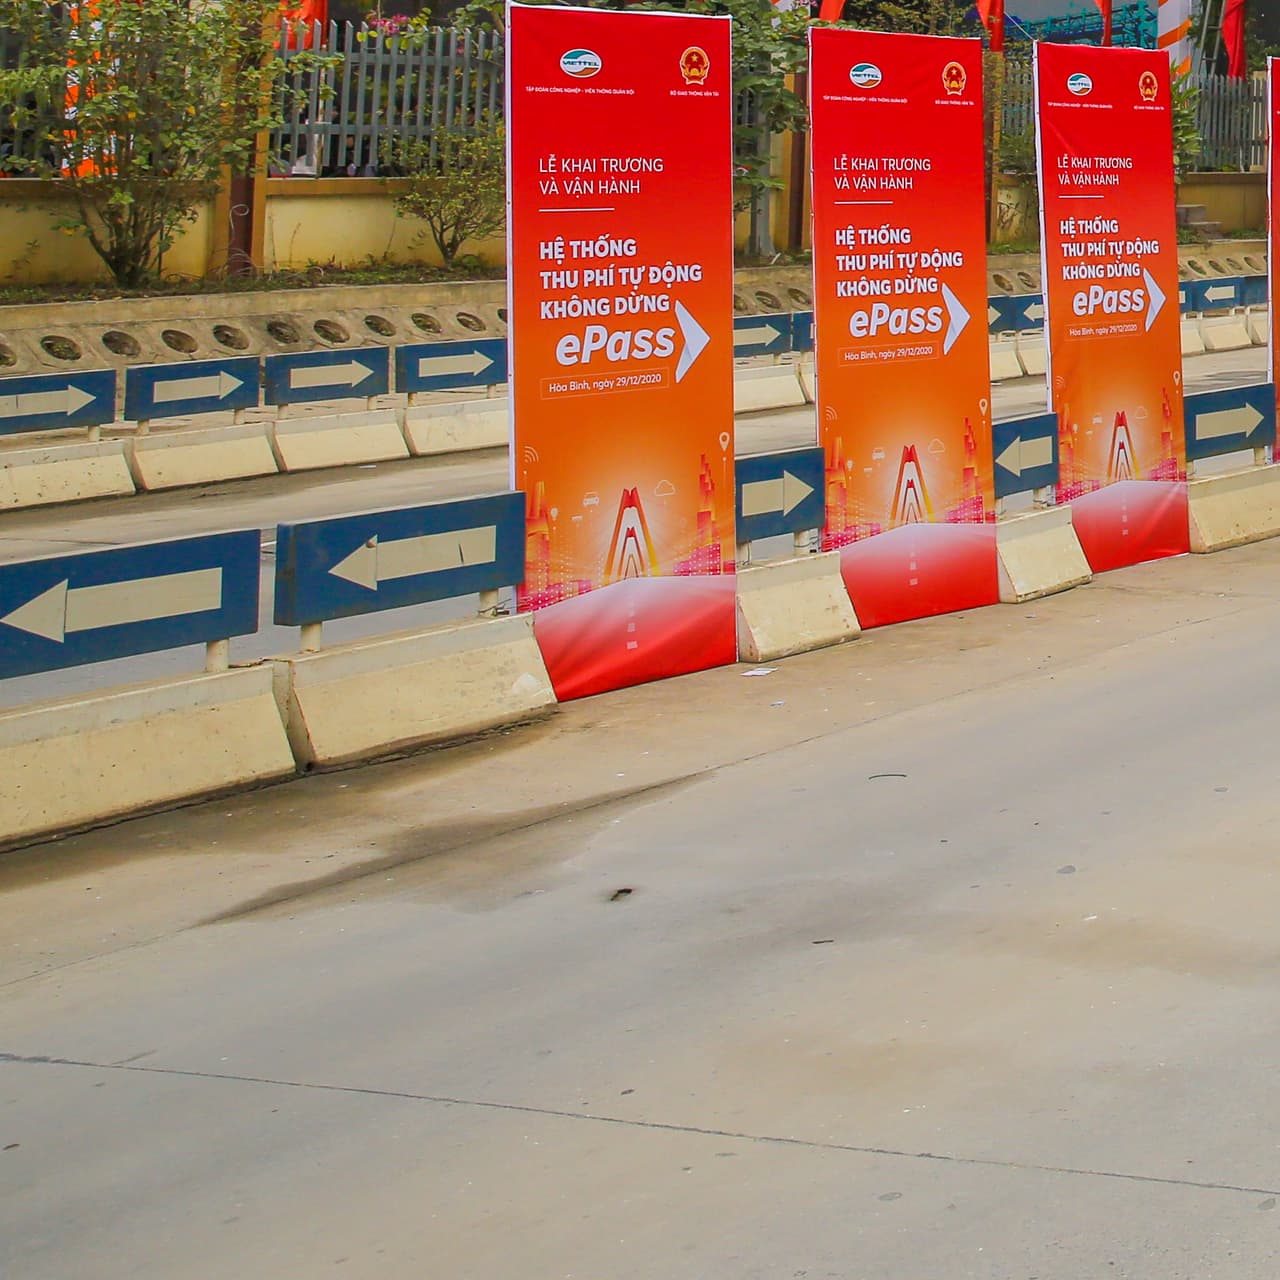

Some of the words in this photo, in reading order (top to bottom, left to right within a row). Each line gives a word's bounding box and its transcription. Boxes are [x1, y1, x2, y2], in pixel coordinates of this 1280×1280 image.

[539, 153, 557, 173] LỄ
[562, 158, 596, 173] KHAI
[600, 157, 665, 173] TRƯƠNG
[834, 154, 848, 170] LỄ
[851, 158, 878, 170] KHAI
[882, 157, 931, 170] TRƯƠNG
[1057, 153, 1069, 169] LỄ
[1071, 158, 1091, 169] KHAI
[1094, 157, 1133, 169] TRƯƠNG
[539, 176, 559, 195] VÀ
[563, 176, 594, 199] VẬN
[599, 176, 640, 195] HÀNH
[834, 174, 850, 189] VÀ
[853, 174, 877, 192] VẬN
[880, 173, 913, 189] HÀNH
[1058, 171, 1070, 185] VÀ
[1072, 171, 1092, 188] VẬN
[1093, 171, 1119, 185] HÀNH
[835, 225, 855, 250] HỆ
[858, 224, 911, 244] THỐNG
[1060, 217, 1076, 239] HỆ
[1077, 215, 1119, 234] THỐNG
[540, 236, 565, 265] HỆ
[569, 234, 637, 259] THỐNG
[1061, 243, 1084, 257] THU
[1087, 238, 1106, 256] PHÍ
[1108, 240, 1124, 259] TỰ
[1126, 238, 1160, 258] ĐỘNG
[836, 255, 866, 271] THU
[869, 250, 894, 270] PHÍ
[897, 252, 918, 273] TỰ
[920, 249, 963, 272] ĐỘNG
[1063, 261, 1105, 280] KHÔNG
[1107, 259, 1140, 278] DỪNG
[540, 269, 579, 289] THU
[583, 264, 616, 288] PHÍ
[618, 266, 646, 290] TỰ
[648, 261, 703, 288] ĐỘNG
[837, 276, 891, 297] KHÔNG
[894, 274, 938, 295] DỪNG
[540, 294, 611, 320] KHÔNG
[614, 291, 670, 315] DỪNG
[1073, 285, 1145, 317] ePass
[849, 302, 943, 338] ePass
[556, 324, 676, 366] ePass
[549, 383, 567, 393] Hòa
[593, 379, 615, 391] ngày
[616, 373, 662, 387] 29/12/2020
